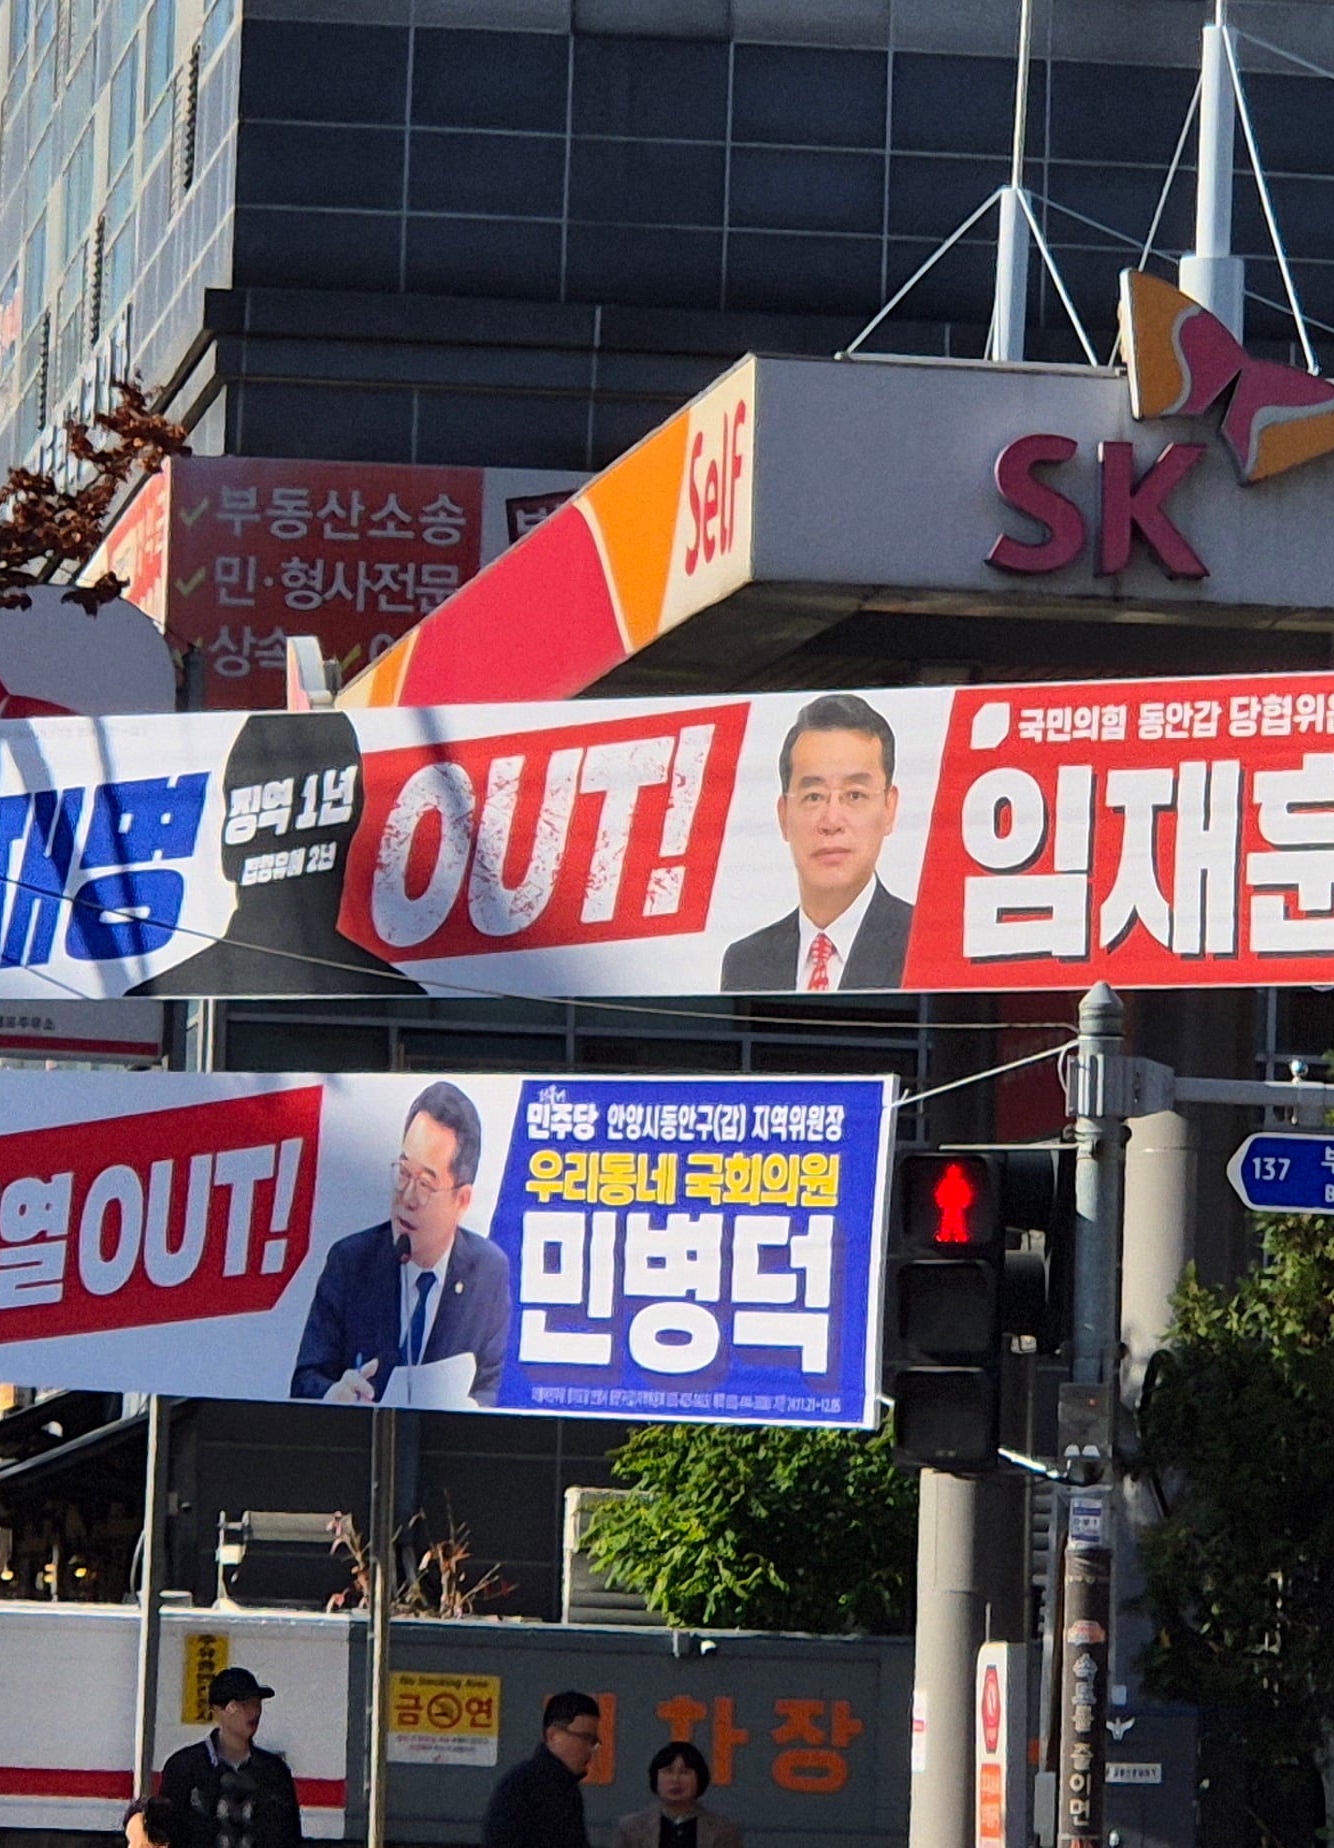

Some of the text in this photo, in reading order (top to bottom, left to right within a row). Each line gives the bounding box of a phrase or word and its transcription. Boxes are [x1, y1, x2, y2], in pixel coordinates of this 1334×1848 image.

[216, 485, 466, 546] 부동산소송
[685, 399, 746, 575] Self
[985, 433, 1209, 580] SK
[215, 556, 460, 612] 민·형사전문
[1018, 706, 1126, 744] 국민의힘
[1137, 701, 1222, 739] 동안갑
[225, 765, 358, 845] 징역 1년
[371, 723, 715, 947] OUT!
[527, 1104, 598, 1141] 민주당
[607, 1104, 845, 1142] 안양시동안구(갑) 지역위원장
[525, 1150, 839, 1207] 우리동네 국회의원
[1253, 1158, 1290, 1182] 137
[81, 1136, 305, 1294] OUT!
[518, 1210, 835, 1374] 민병덕
